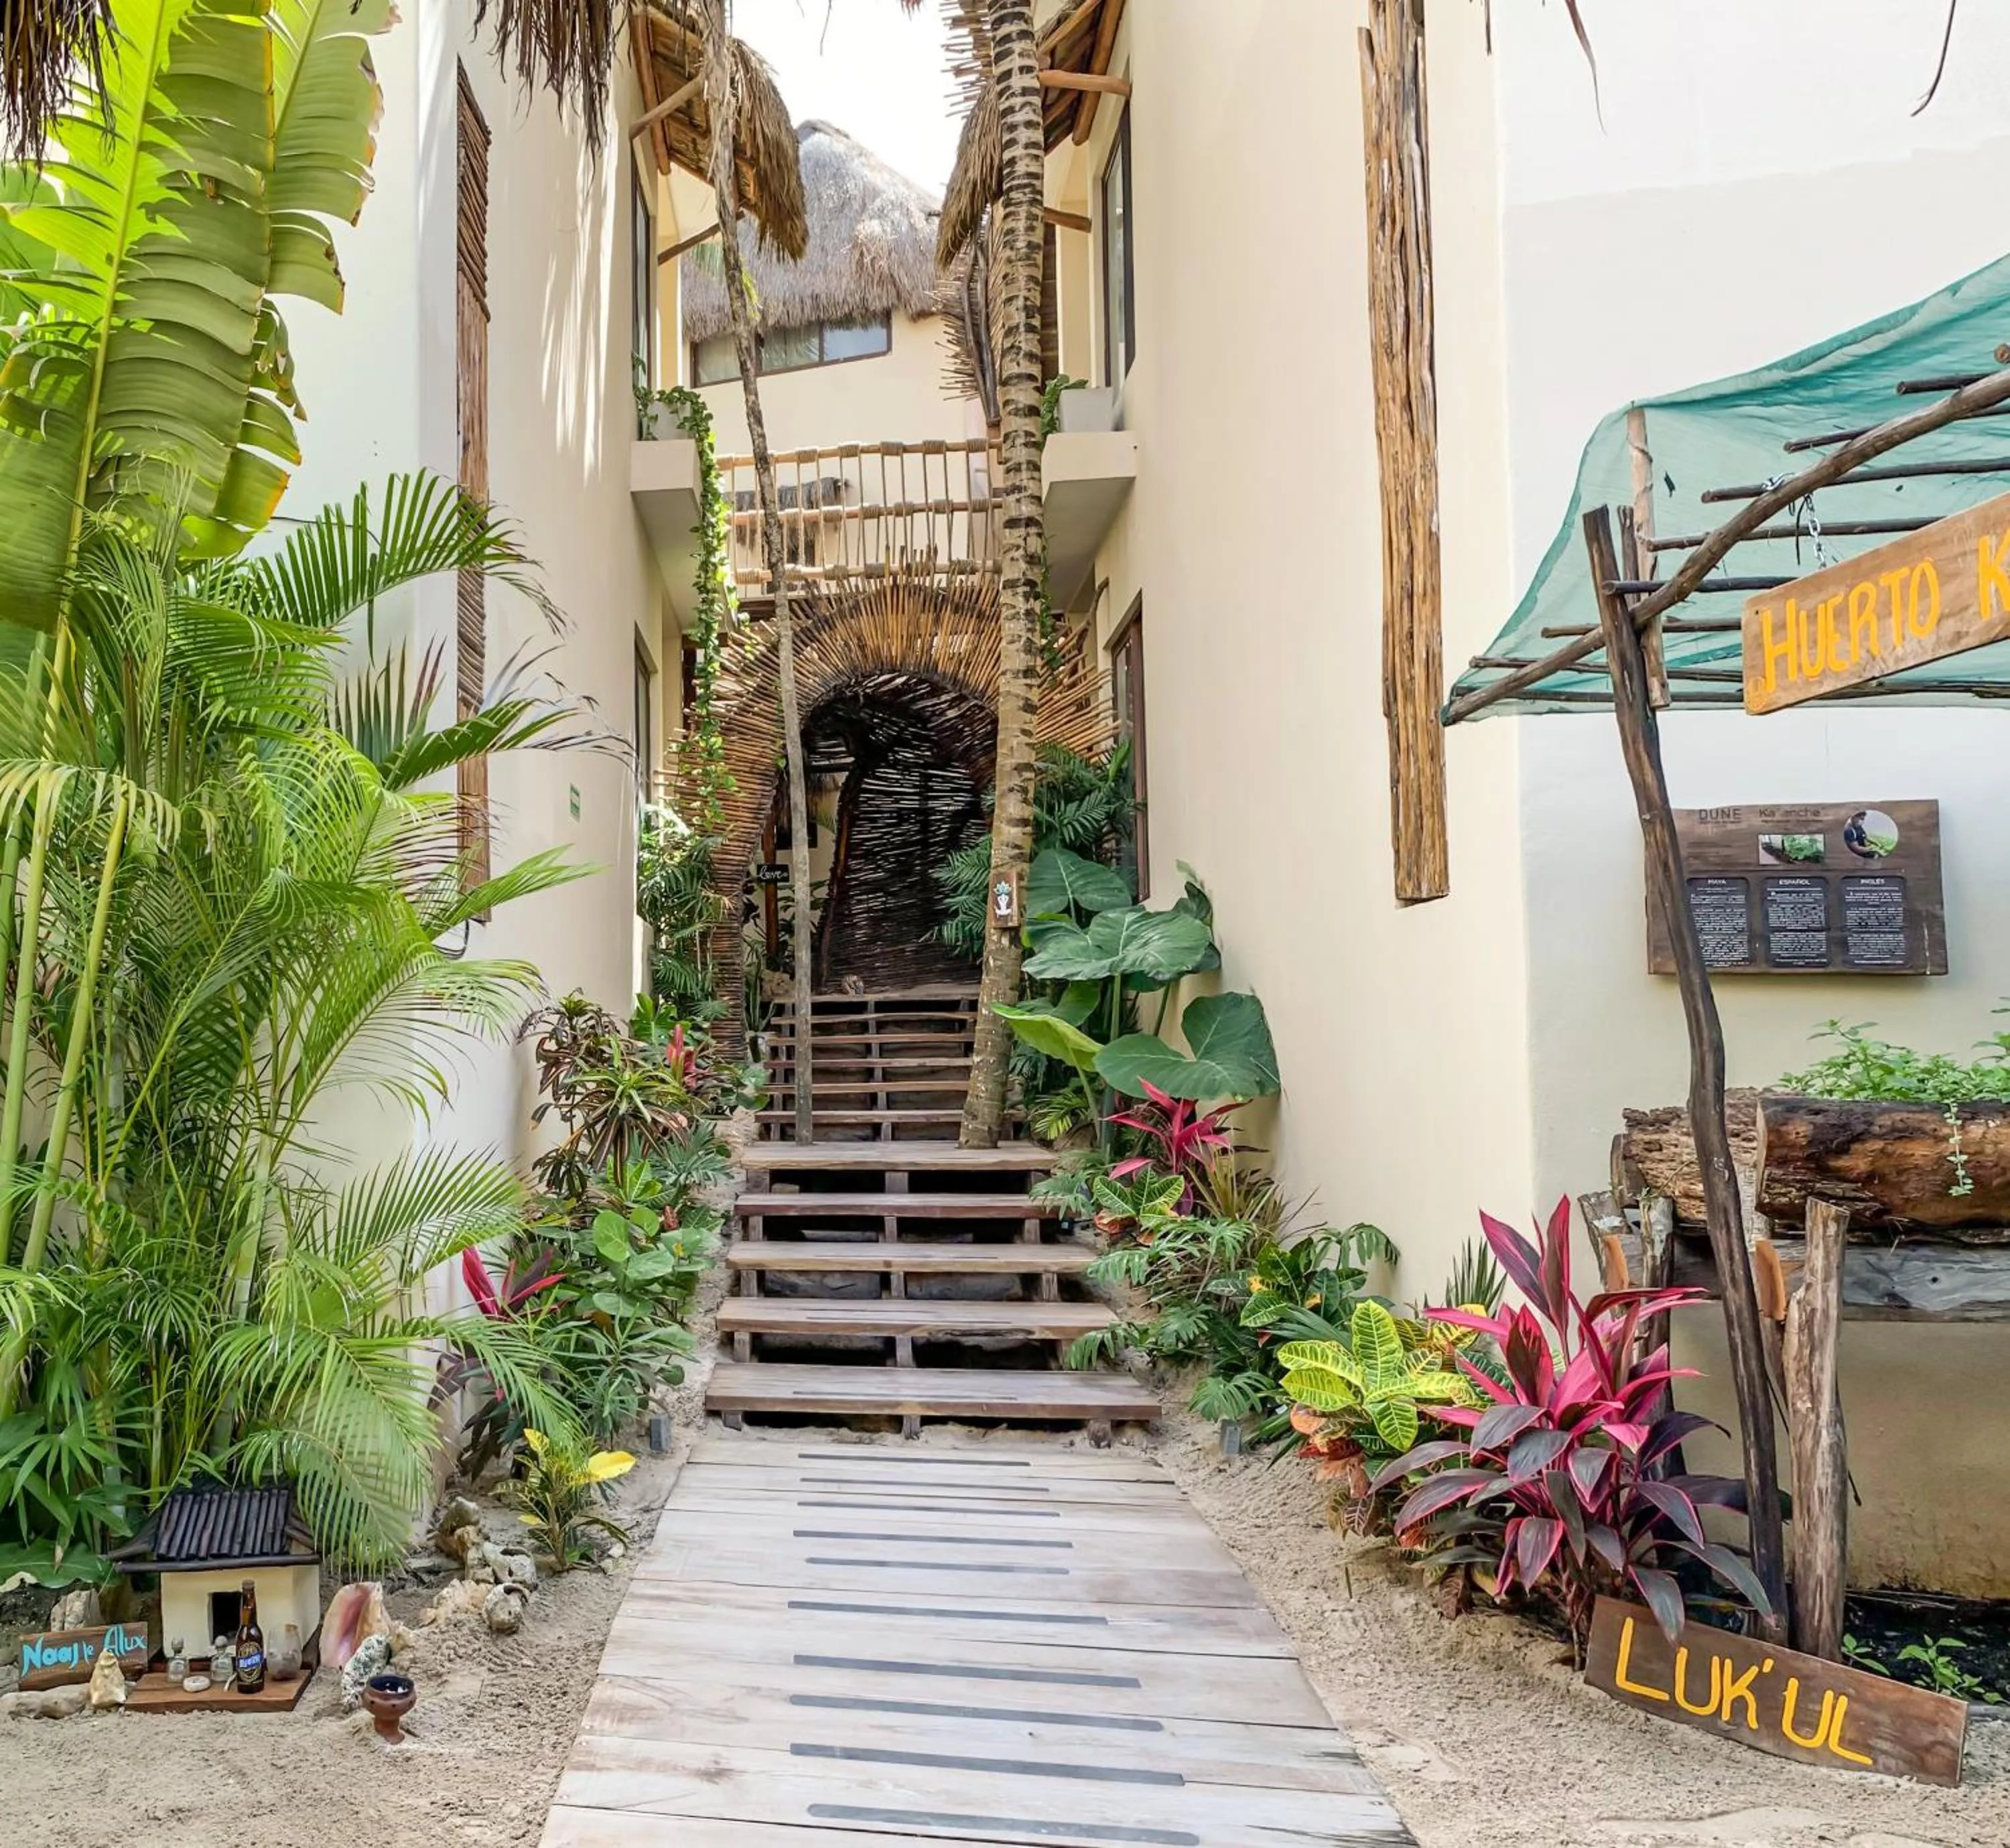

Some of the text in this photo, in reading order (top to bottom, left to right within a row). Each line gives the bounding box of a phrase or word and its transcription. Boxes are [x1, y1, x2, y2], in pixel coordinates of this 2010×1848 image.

[1761, 557, 1940, 693] HUERTO
[1698, 808, 1742, 820] DUNE
[104, 1624, 147, 1658] Alux
